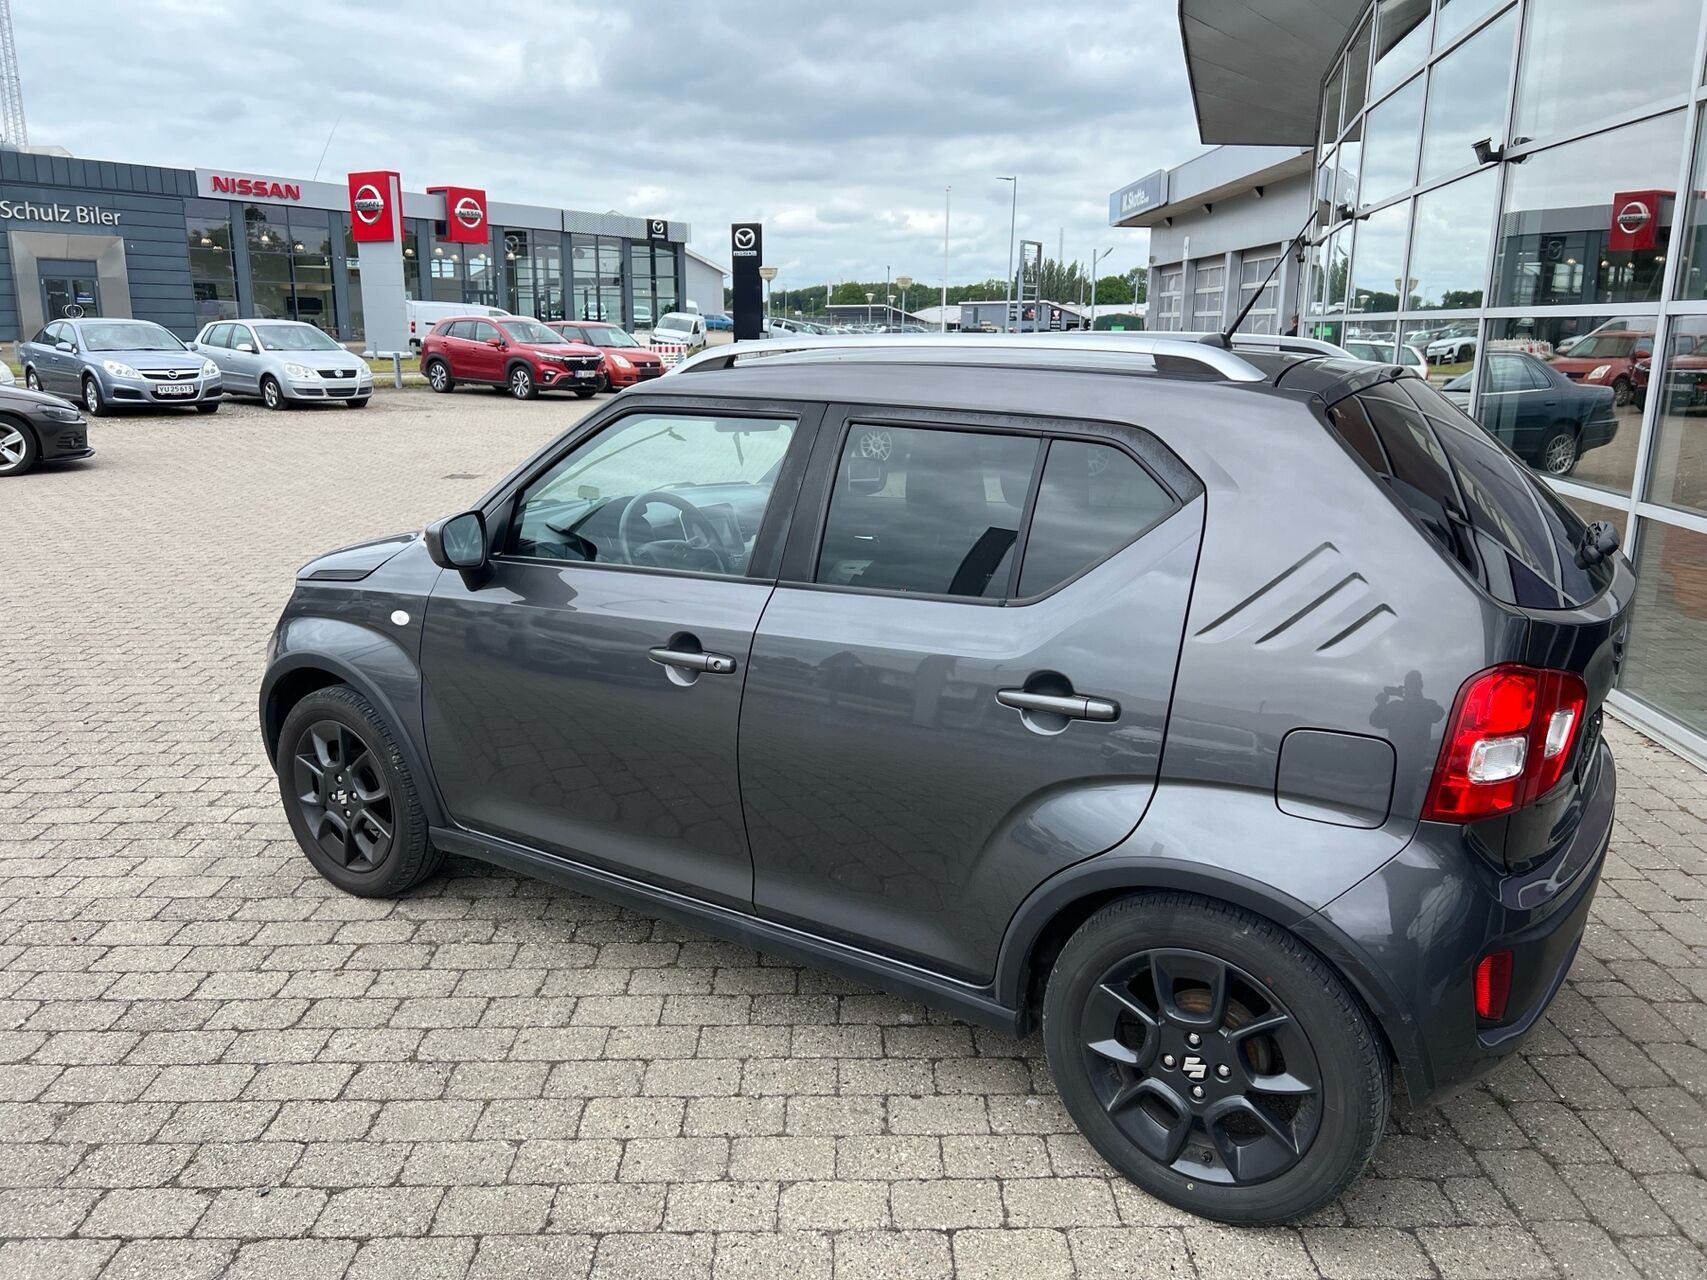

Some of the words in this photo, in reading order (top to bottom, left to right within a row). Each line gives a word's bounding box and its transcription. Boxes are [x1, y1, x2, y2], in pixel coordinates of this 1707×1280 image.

[211, 175, 301, 200] NISSAN
[0, 200, 72, 222] Schulz
[75, 205, 121, 226] Biler
[355, 200, 381, 209] NISSAN
